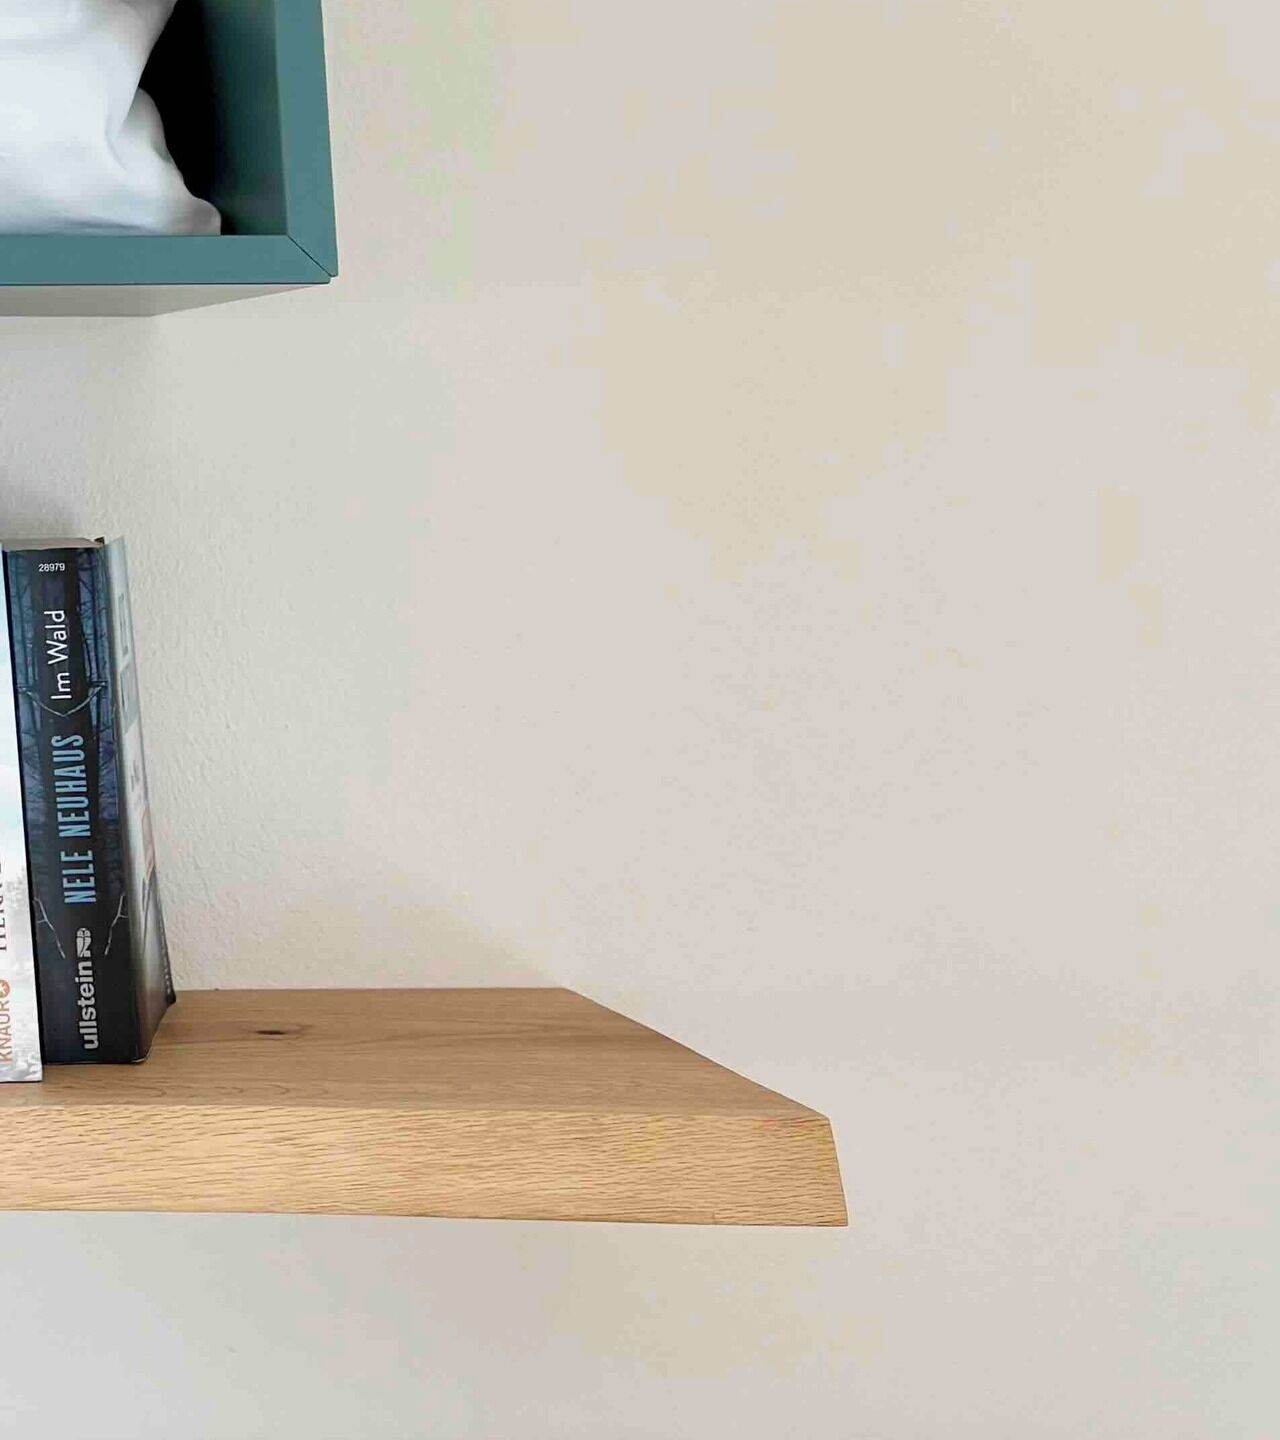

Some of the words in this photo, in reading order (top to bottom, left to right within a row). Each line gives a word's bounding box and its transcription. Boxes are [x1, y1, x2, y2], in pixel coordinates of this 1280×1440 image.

[38, 562, 66, 573] 28979
[44, 610, 69, 665] Wald
[50, 672, 73, 701] Im
[50, 734, 91, 838] NEUHAUS
[60, 850, 97, 904] NELE
[75, 961, 100, 1050] ullstein
